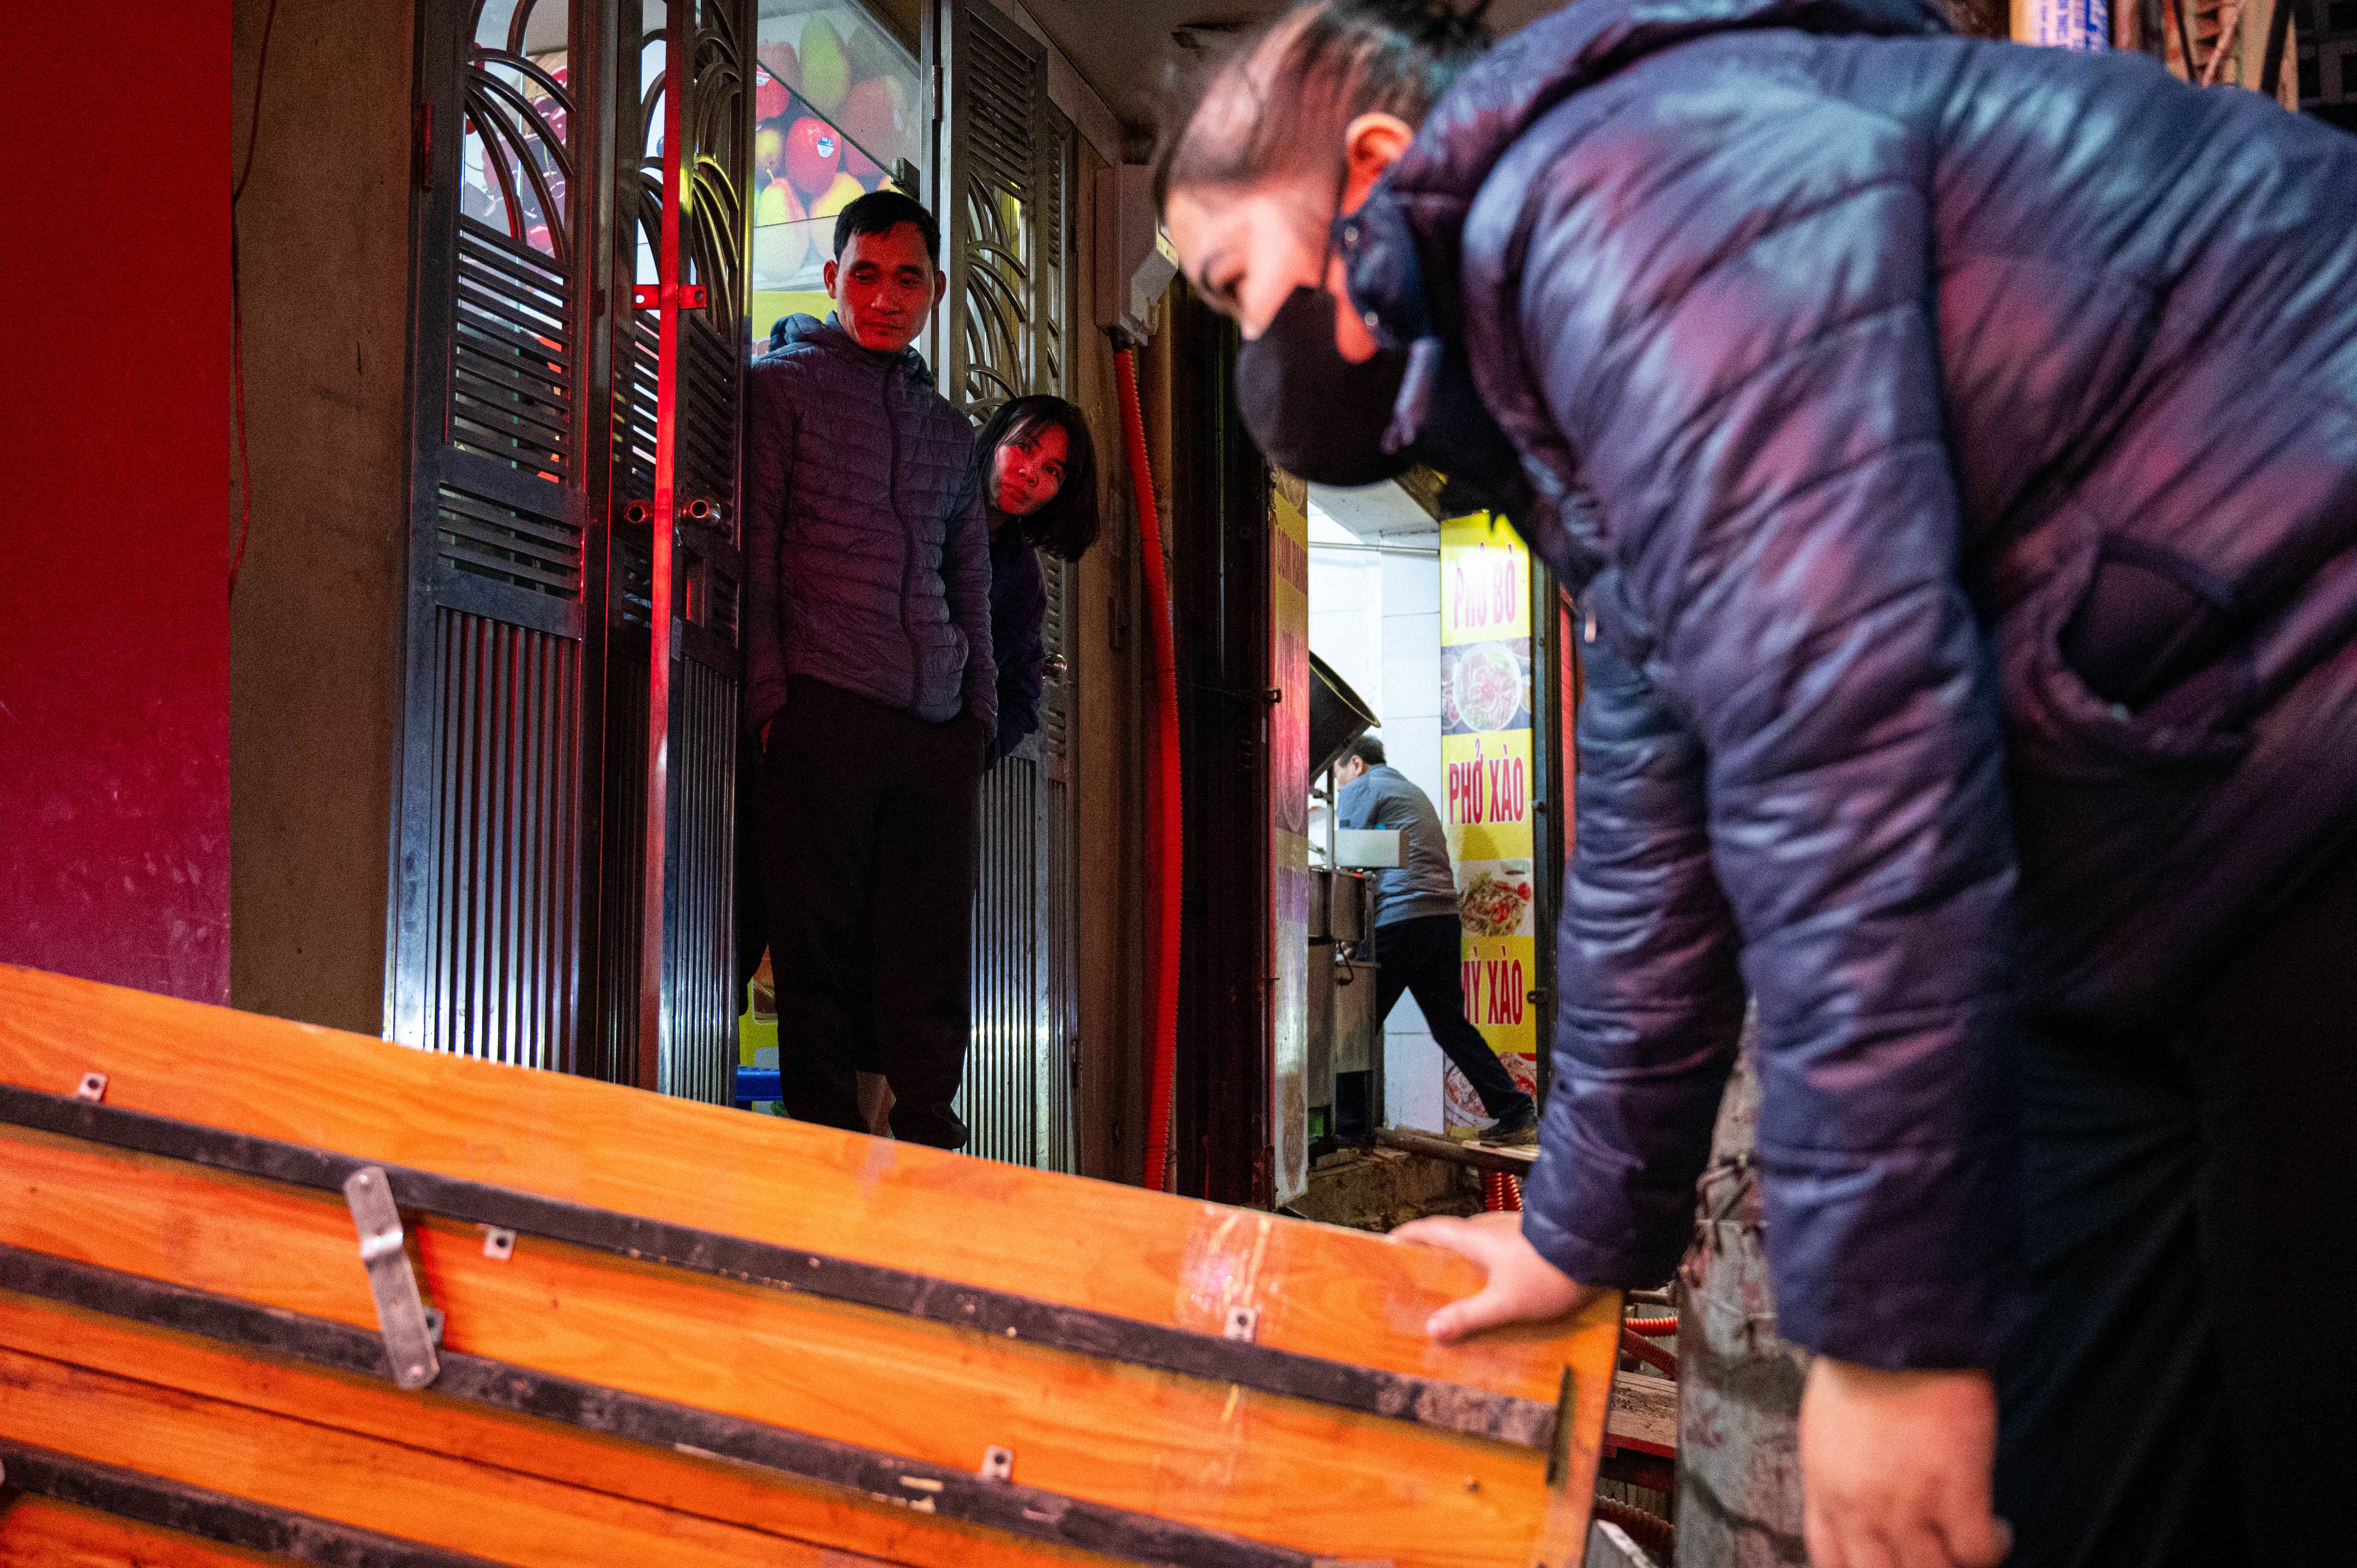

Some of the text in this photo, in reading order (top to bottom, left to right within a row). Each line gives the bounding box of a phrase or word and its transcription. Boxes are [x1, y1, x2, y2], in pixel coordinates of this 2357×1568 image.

[1493, 544, 1516, 624] BÒ
[1449, 738, 1524, 825] PHỞ XÀO
[1487, 945, 1522, 1025] XÀO
